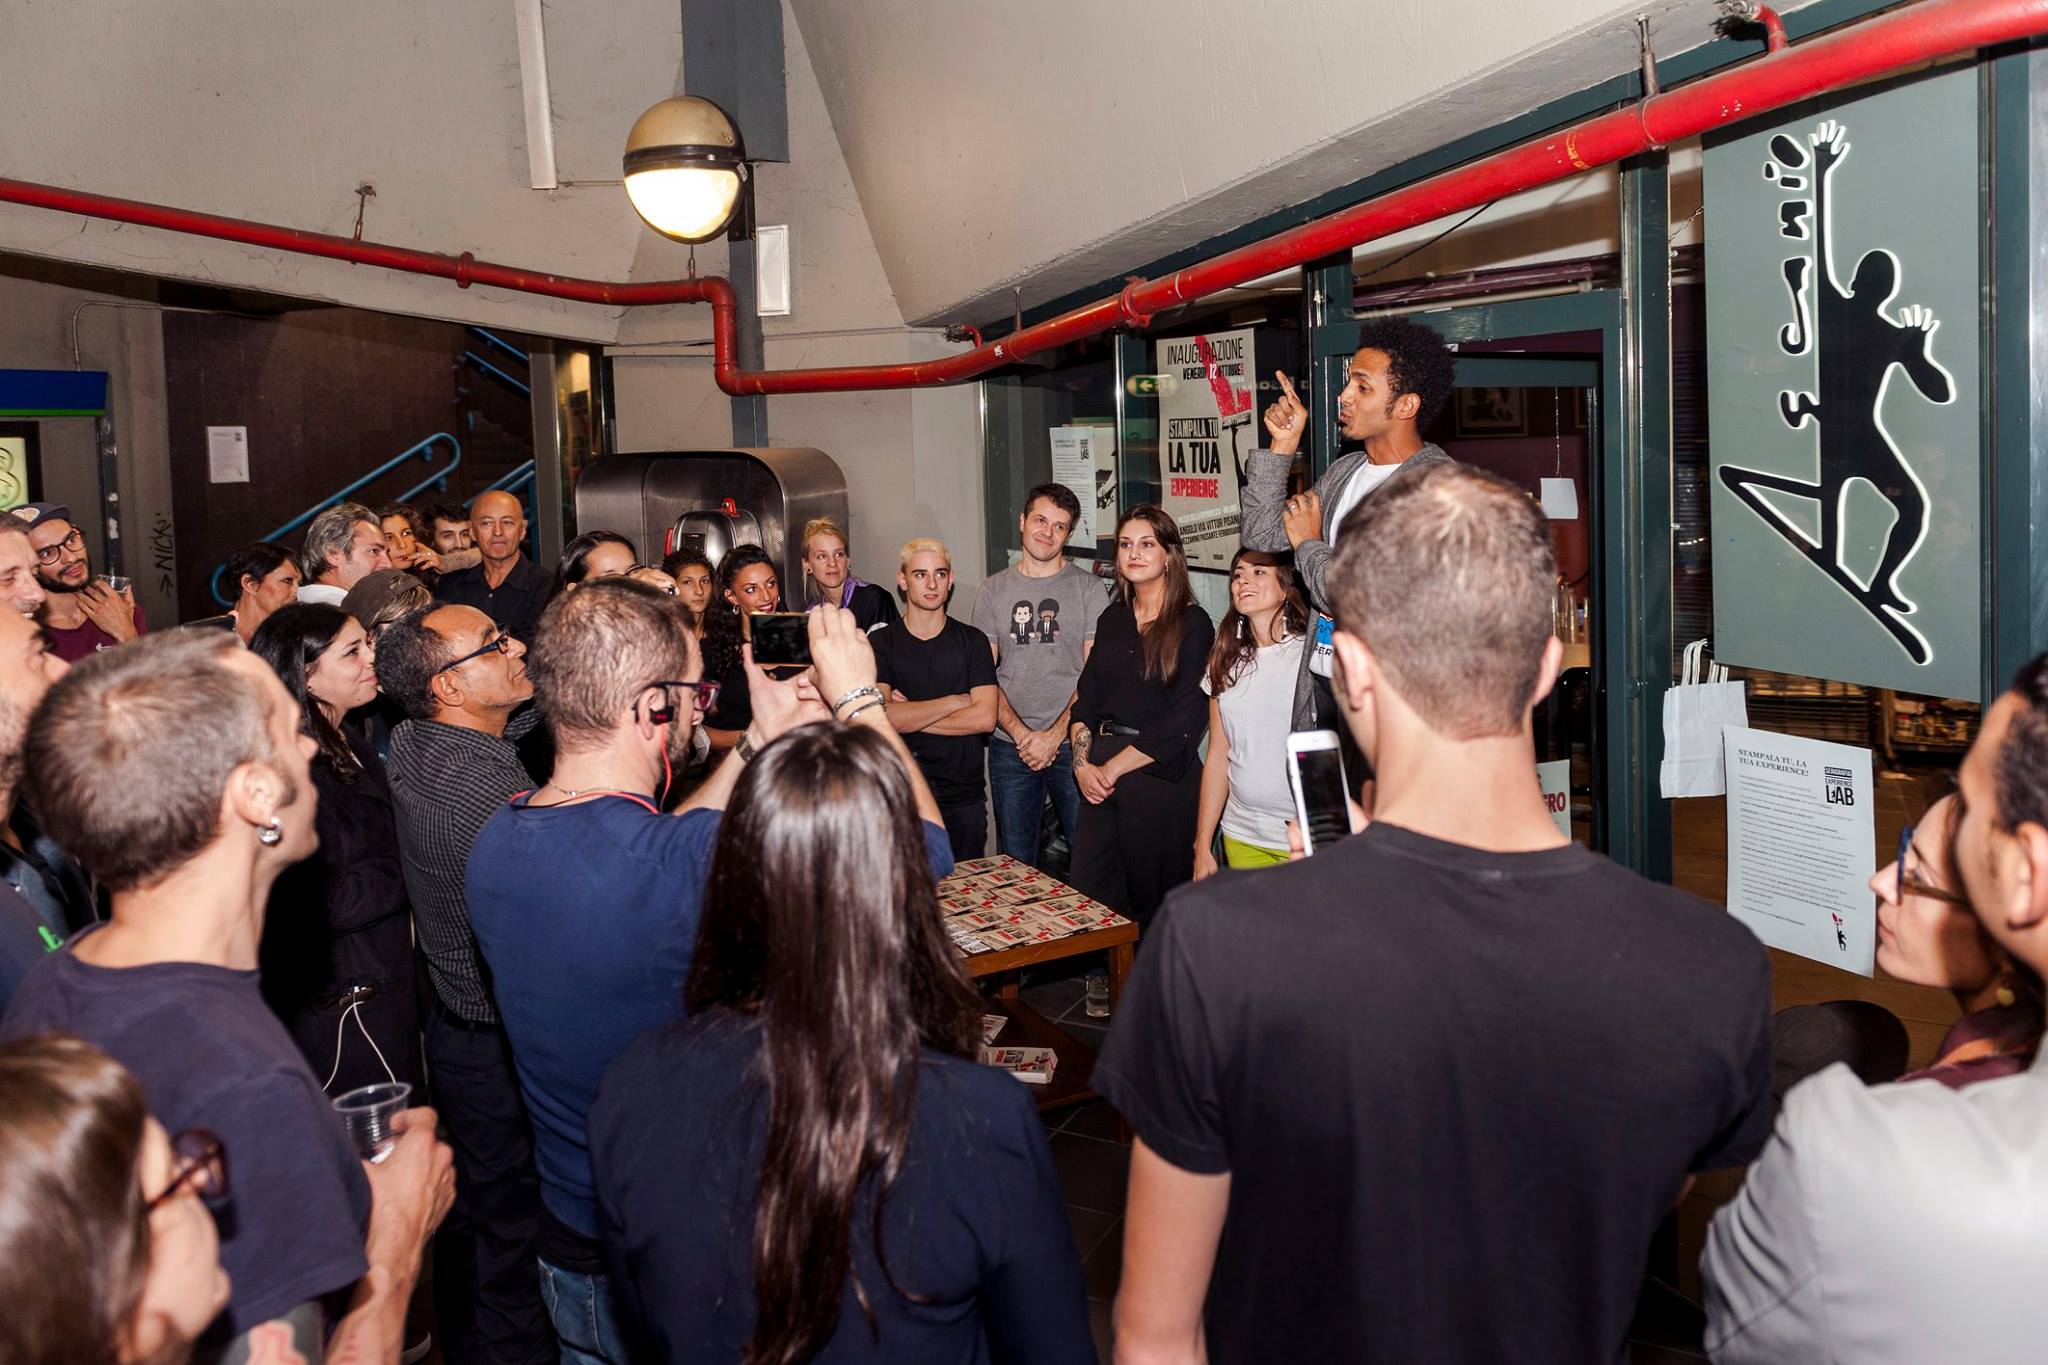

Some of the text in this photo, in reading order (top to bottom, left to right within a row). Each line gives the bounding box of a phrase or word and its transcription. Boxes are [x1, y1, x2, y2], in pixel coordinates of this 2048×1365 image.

[1167, 338, 1243, 365] INAUGURAZIONE
[1209, 363, 1217, 380] 12
[1169, 418, 1218, 438] STAMPALA TU
[1168, 442, 1221, 474] LA TUA
[1170, 478, 1218, 498] EXPERIENCE
[1738, 749, 1780, 762] STAMPALA
[1796, 759, 1808, 768] LA
[1739, 757, 1809, 776] TUA EXPERIENCE!
[1826, 785, 1854, 806] LAB
